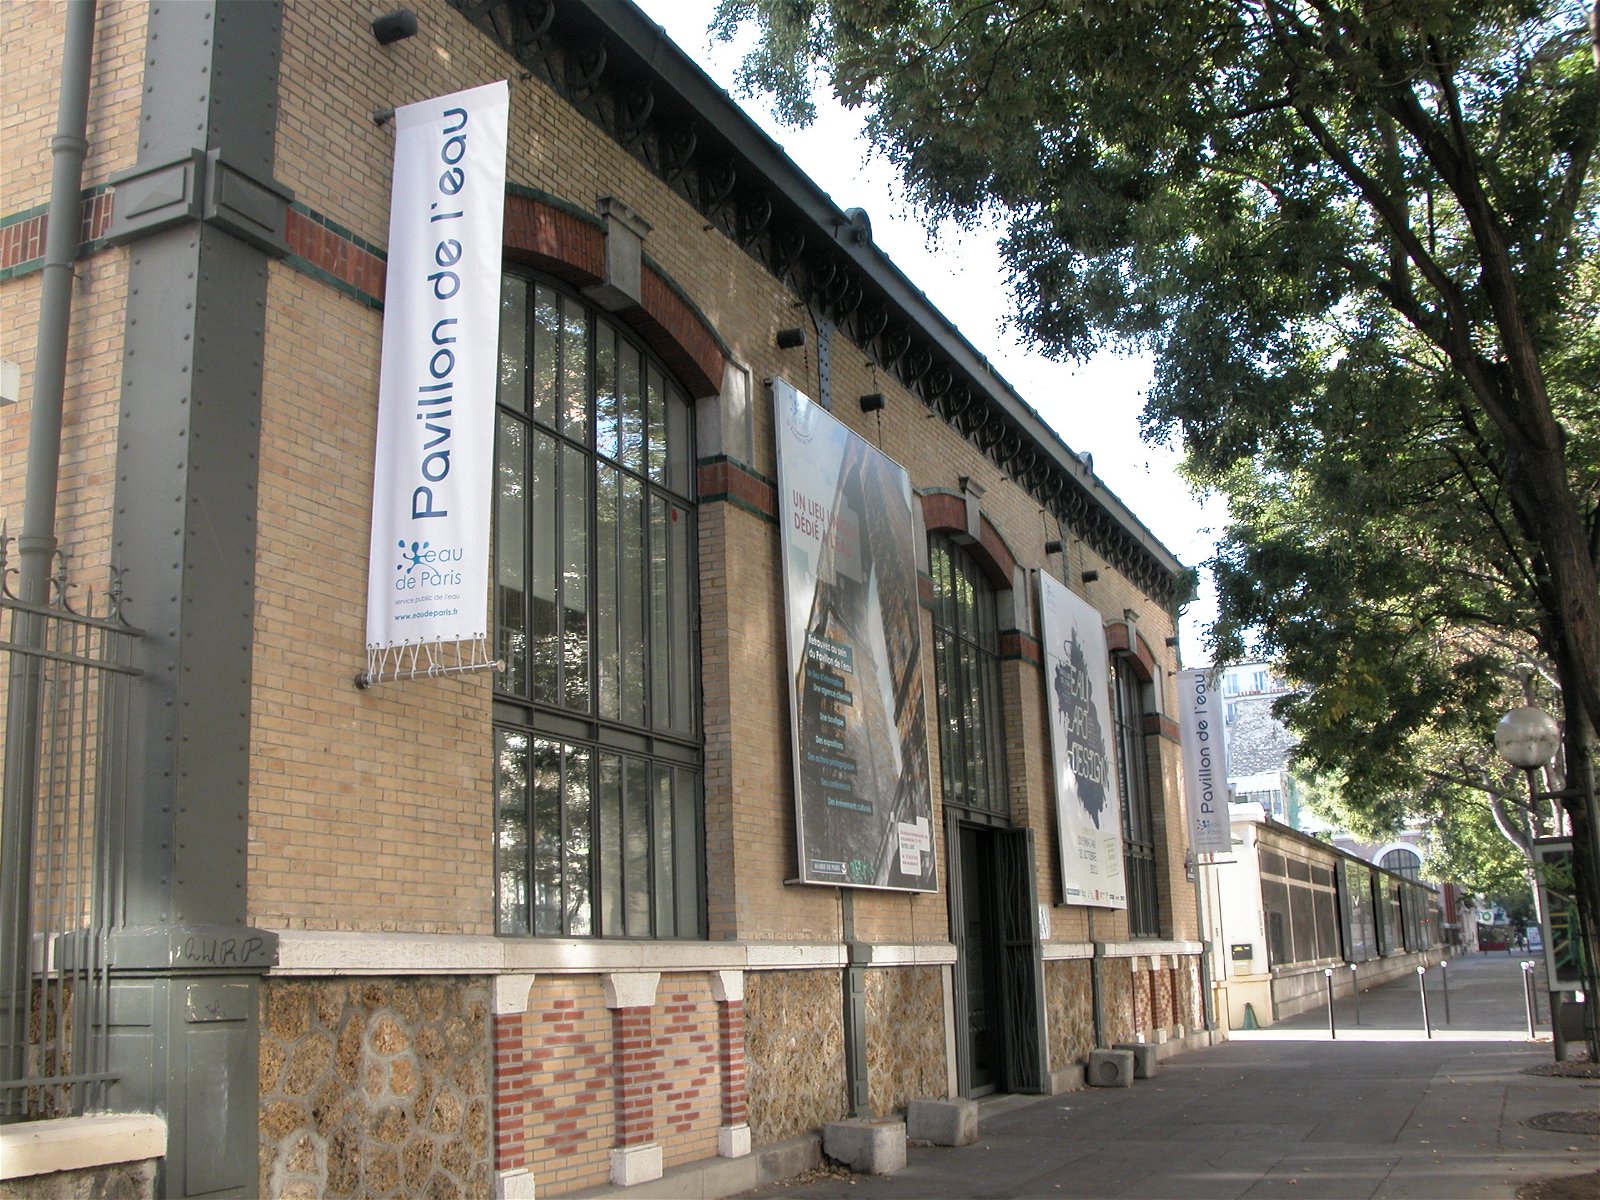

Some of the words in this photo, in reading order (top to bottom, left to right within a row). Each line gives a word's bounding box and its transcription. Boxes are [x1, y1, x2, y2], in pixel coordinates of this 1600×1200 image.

[430, 107, 468, 223] l'eau
[427, 238, 463, 300] de
[412, 318, 458, 520] Pavillon
[792, 489, 806, 511] UN
[808, 497, 825, 522] LIEU
[793, 511, 820, 541] DÉDIÉ
[425, 548, 463, 563] eau
[395, 575, 416, 590] de
[421, 569, 462, 587] Paris
[394, 597, 416, 605] service
[415, 594, 432, 603] public
[394, 608, 458, 621] www.eaudeparis.fr
[816, 650, 834, 665] Pavillon
[834, 658, 841, 668] de
[1070, 664, 1089, 702] EAU
[1195, 674, 1207, 714] l'eau
[1070, 705, 1088, 739] ART
[1196, 720, 1209, 742] de
[1072, 741, 1109, 786] DESIGN
[1199, 747, 1215, 814] Pavillon
